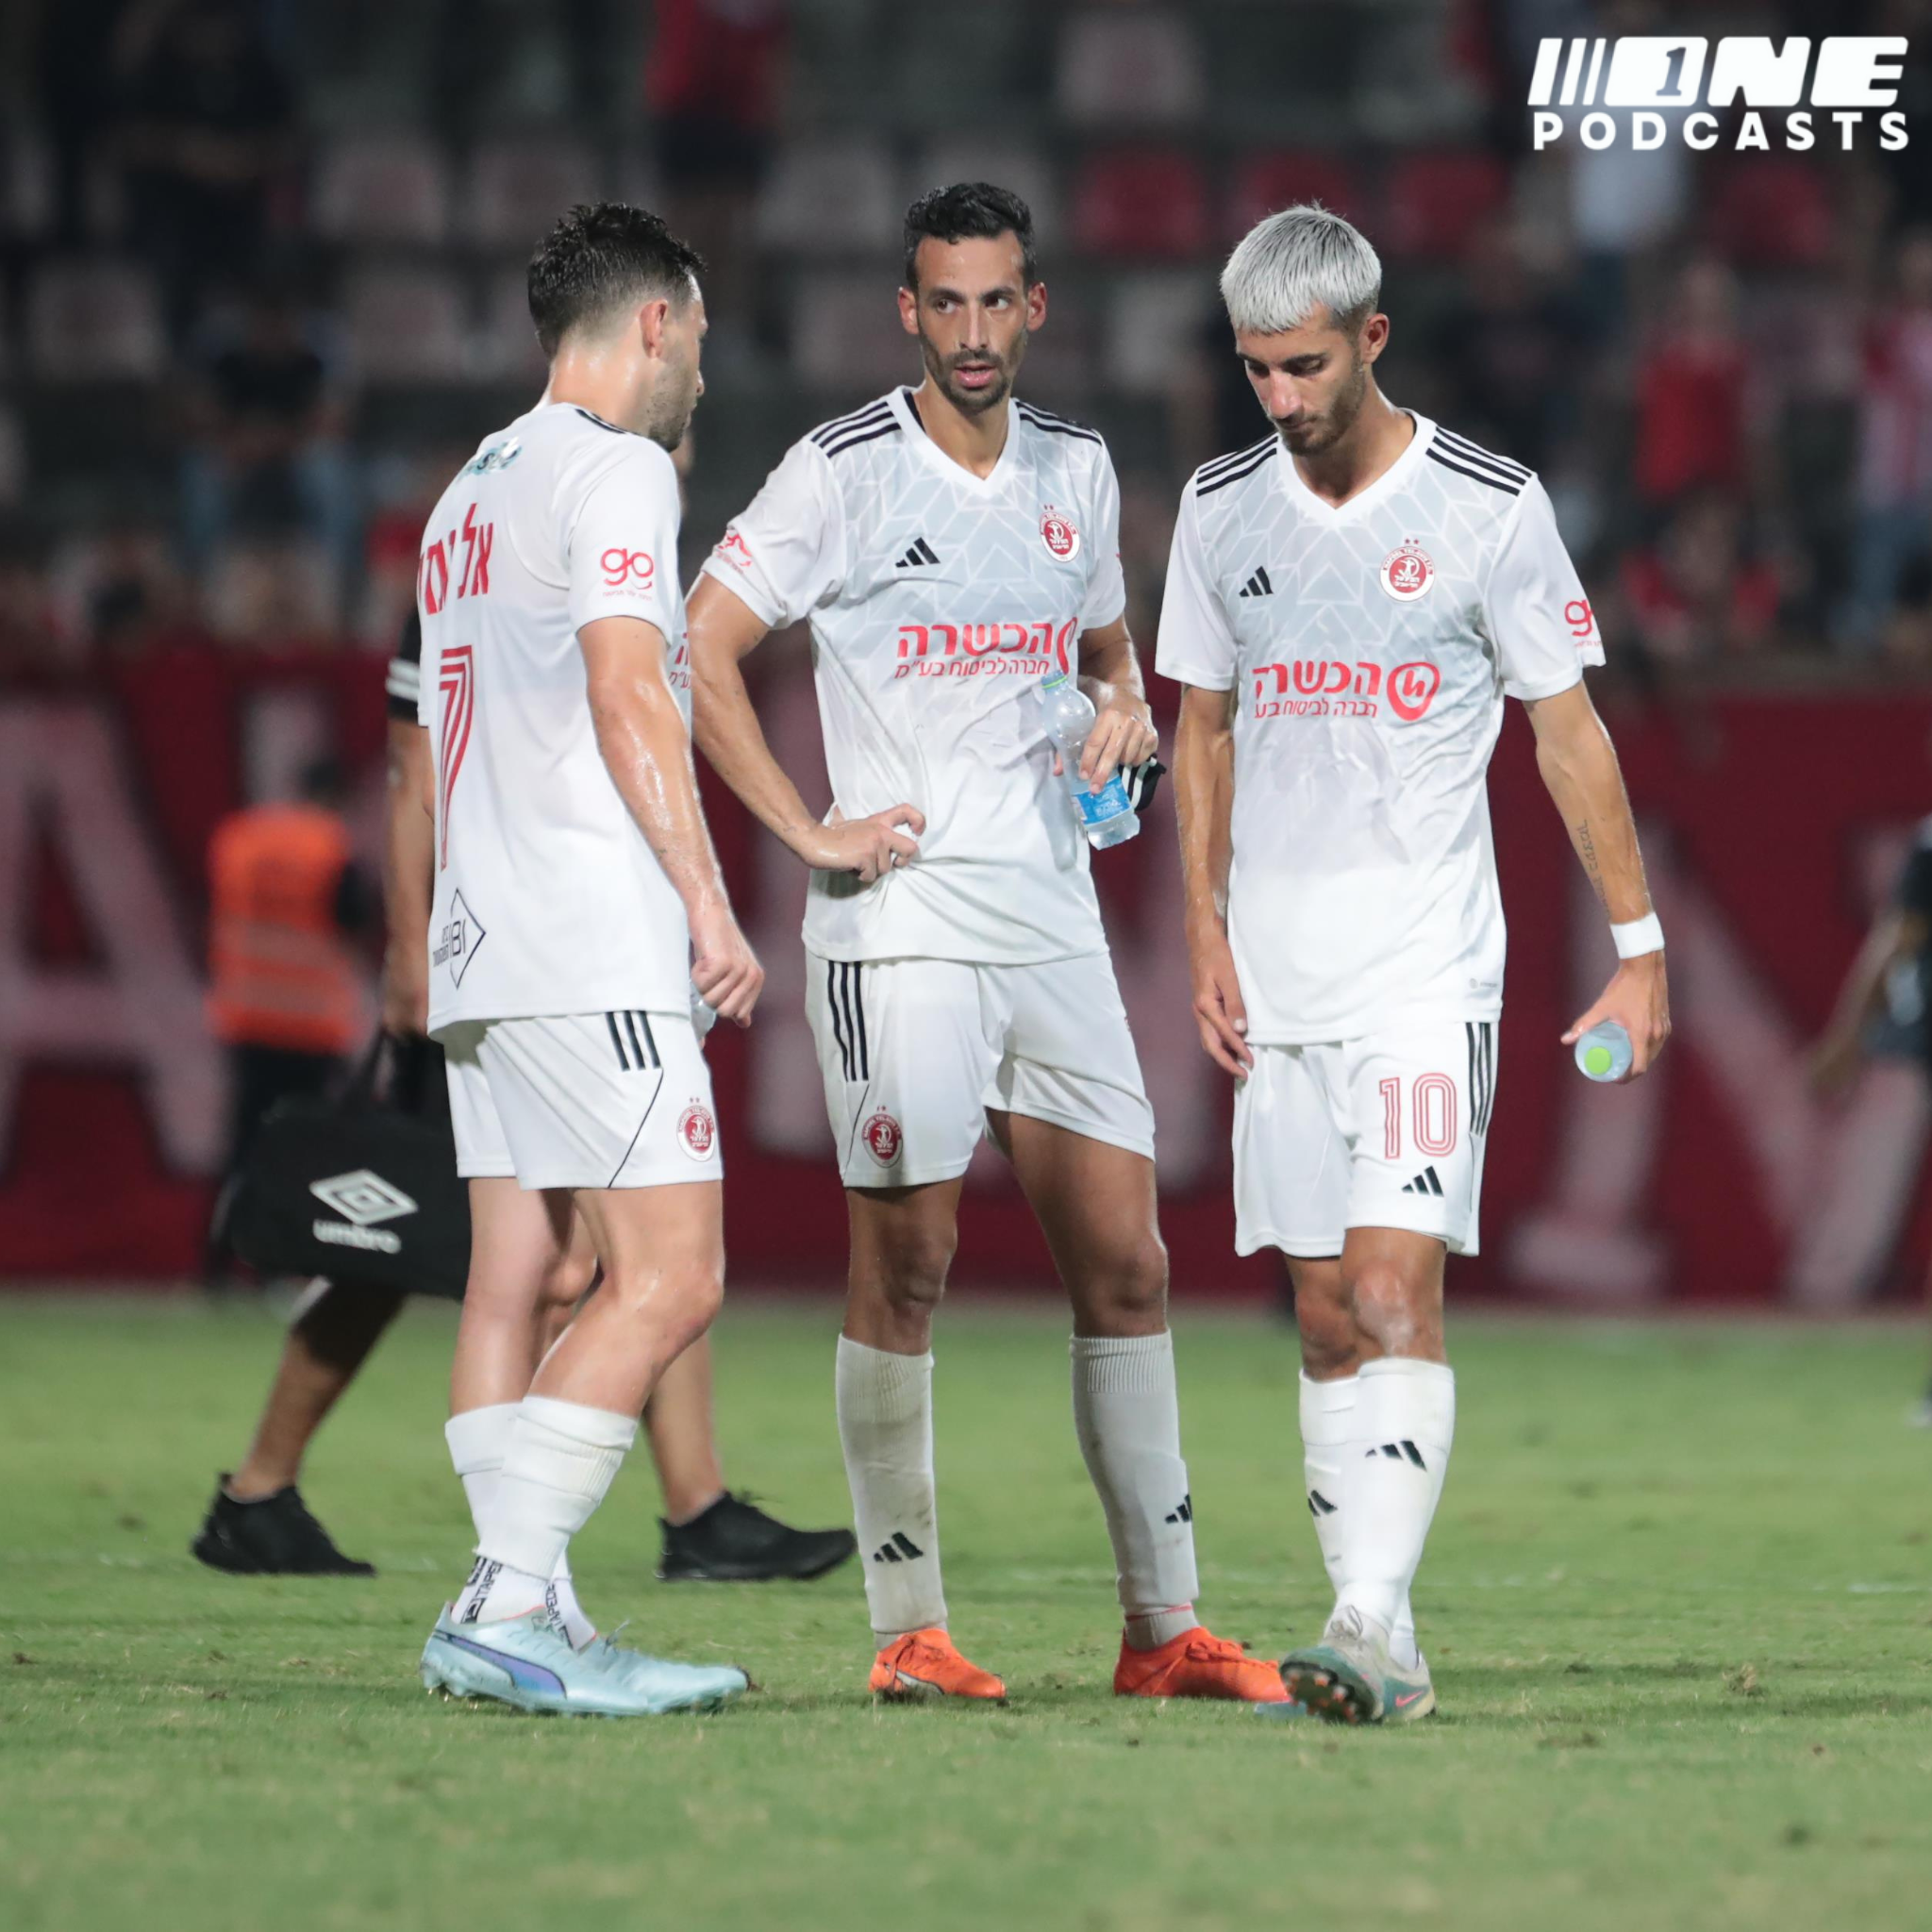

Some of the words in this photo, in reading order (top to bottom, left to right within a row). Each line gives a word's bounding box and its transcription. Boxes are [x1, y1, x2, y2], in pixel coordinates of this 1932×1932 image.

[417, 502, 494, 616] אלימ
[600, 548, 655, 589] go
[897, 623, 1054, 658] הכשרה
[1564, 599, 1595, 637] g
[439, 644, 475, 874] 7
[1378, 1072, 1457, 1160] 10
